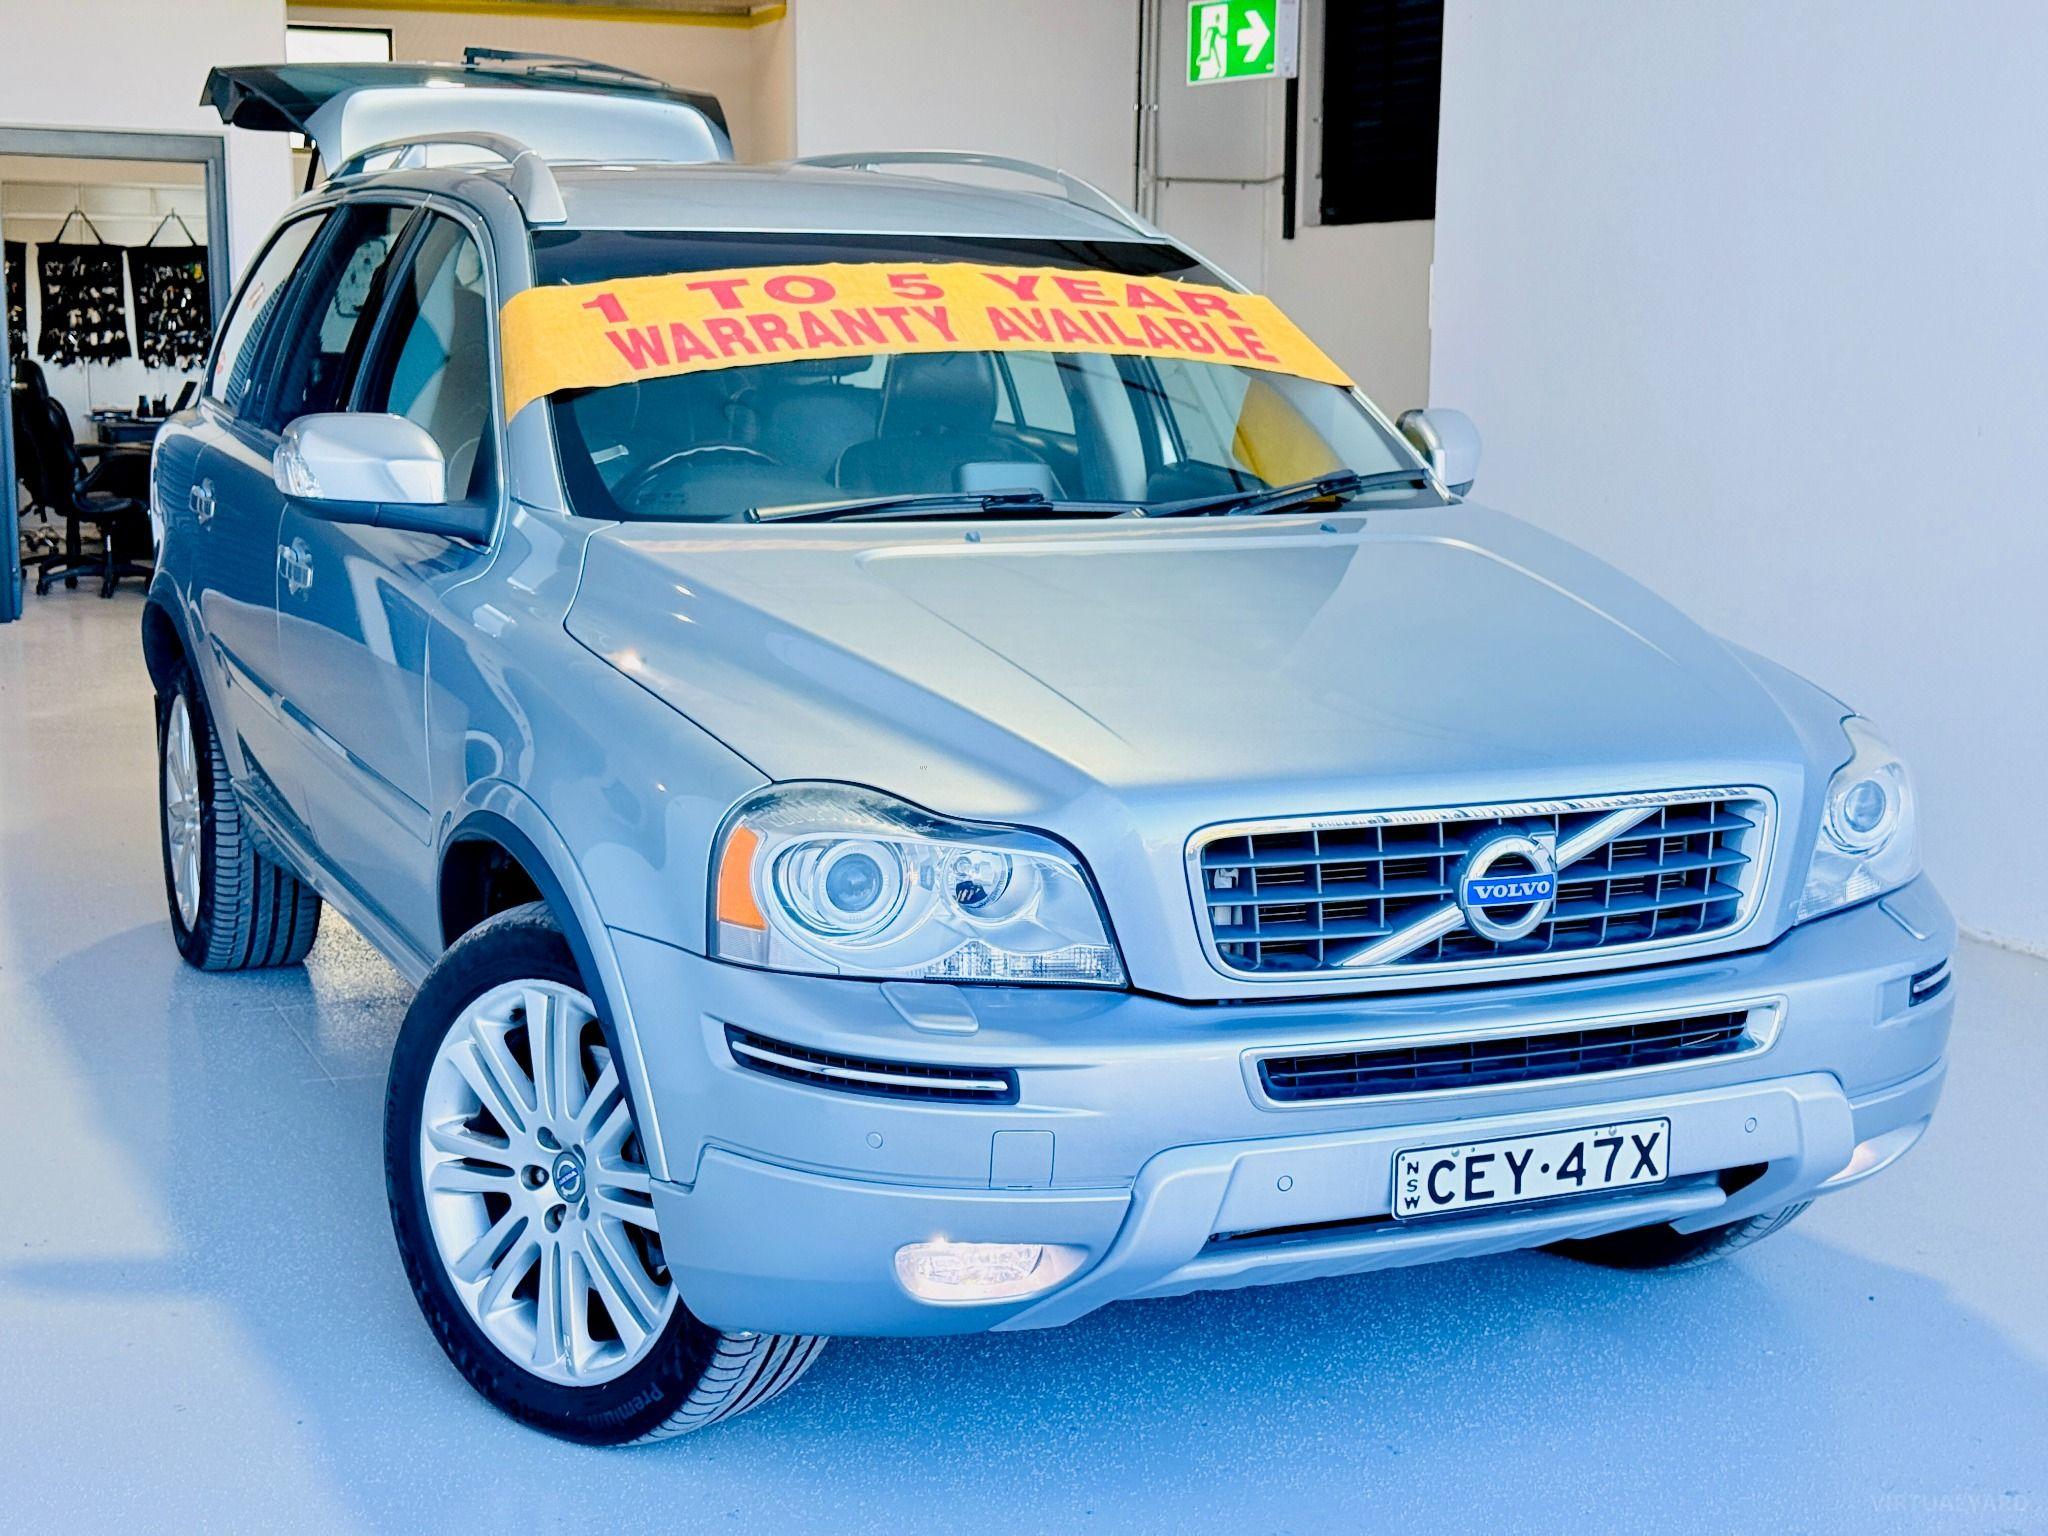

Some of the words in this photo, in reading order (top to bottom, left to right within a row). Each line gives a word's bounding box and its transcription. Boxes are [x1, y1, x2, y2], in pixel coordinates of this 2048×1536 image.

[582, 293, 629, 323] 1
[686, 277, 836, 310] TO
[887, 274, 945, 300] 5
[980, 273, 1243, 320] YEAR
[604, 306, 959, 370] WARRANTY
[985, 306, 1281, 363] AVAILABLE
[1473, 880, 1551, 899] VOLVO
